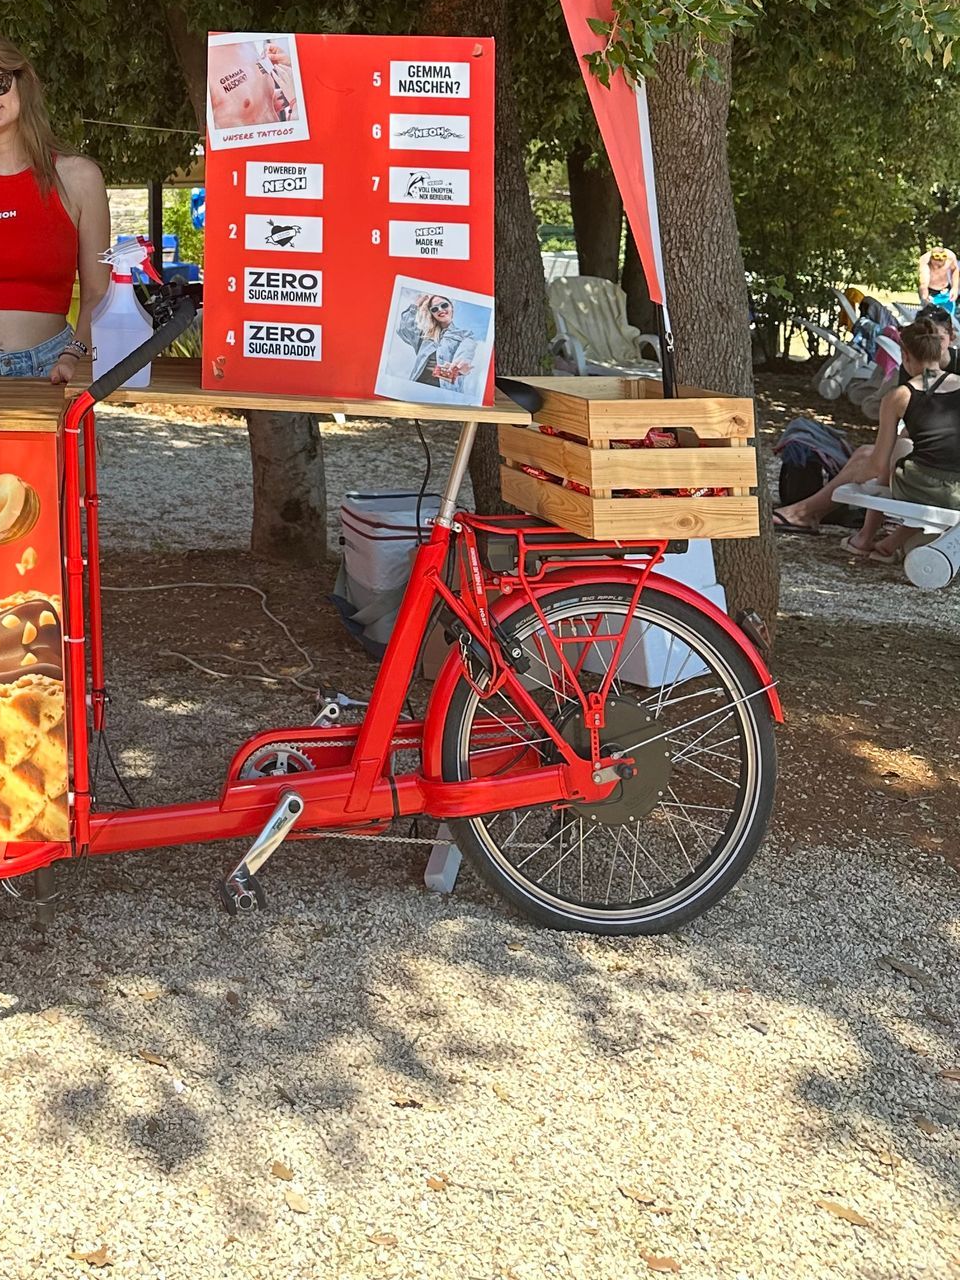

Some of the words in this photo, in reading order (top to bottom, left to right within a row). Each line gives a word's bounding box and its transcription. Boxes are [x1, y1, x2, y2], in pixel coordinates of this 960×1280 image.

[372, 72, 381, 87] 5
[408, 65, 451, 79] GEMMA
[399, 80, 460, 94] NASCHEN?
[223, 132, 254, 142] UNSERE
[257, 128, 294, 138] TATTOOS
[372, 124, 381, 139] 6
[414, 127, 446, 138] NEOH
[232, 170, 238, 186] 1
[263, 166, 296, 175] POWERED
[298, 167, 307, 175] BY
[263, 177, 307, 193] NEOH
[371, 176, 380, 191] 7
[228, 224, 237, 239] 2
[371, 229, 380, 245] 8
[415, 226, 443, 236] NEOH
[416, 238, 433, 246] MADE
[227, 276, 236, 292] 3
[248, 271, 318, 290] ZERO
[248, 289, 279, 301] SUGAR
[280, 291, 318, 303] MOMMY
[226, 330, 235, 346] 4
[249, 325, 315, 343] ZERO
[248, 342, 281, 355] SUGAR
[283, 344, 316, 357] DADDY
